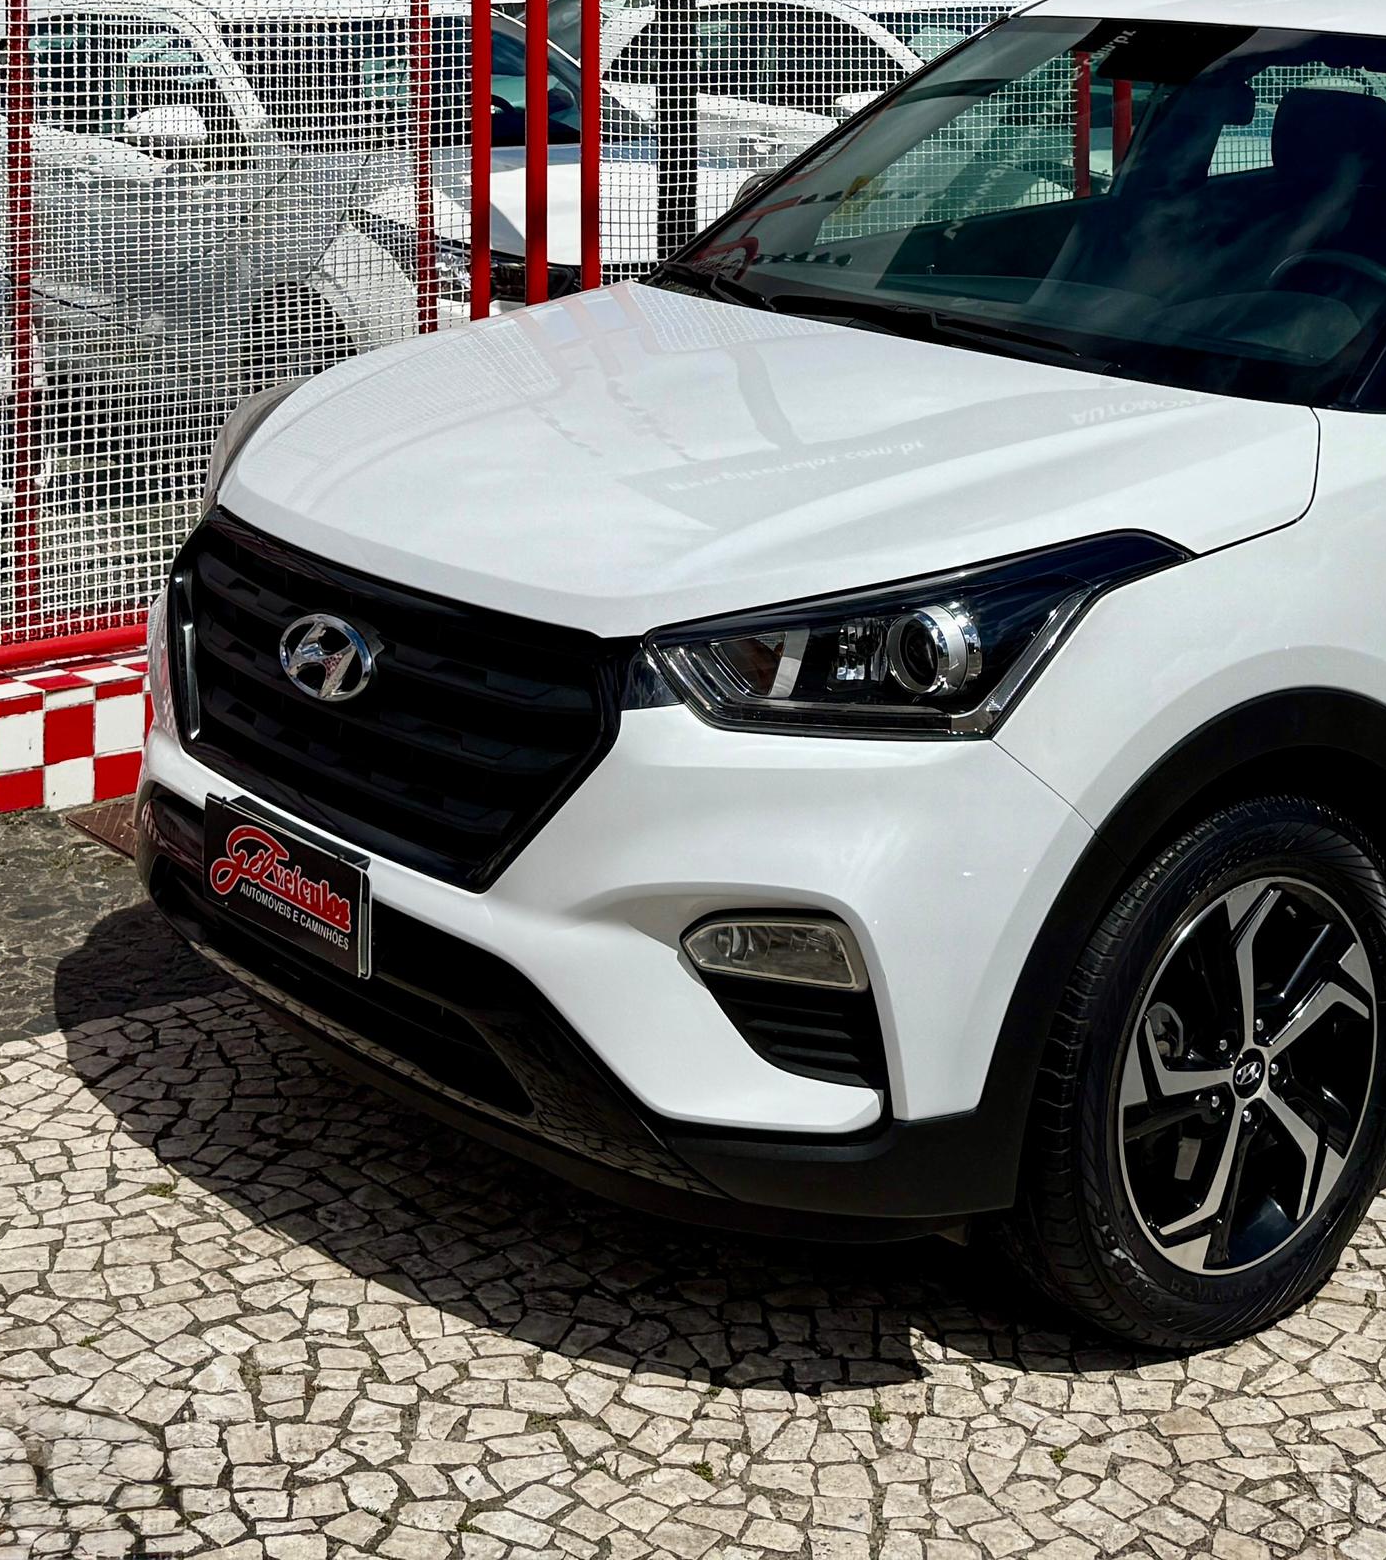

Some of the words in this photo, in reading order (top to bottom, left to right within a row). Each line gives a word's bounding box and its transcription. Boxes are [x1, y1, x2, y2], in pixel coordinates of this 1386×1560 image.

[240, 882, 292, 920] AUTOMÓVEIS
[292, 910, 299, 923] E
[300, 914, 350, 951] CAMINHÕES
